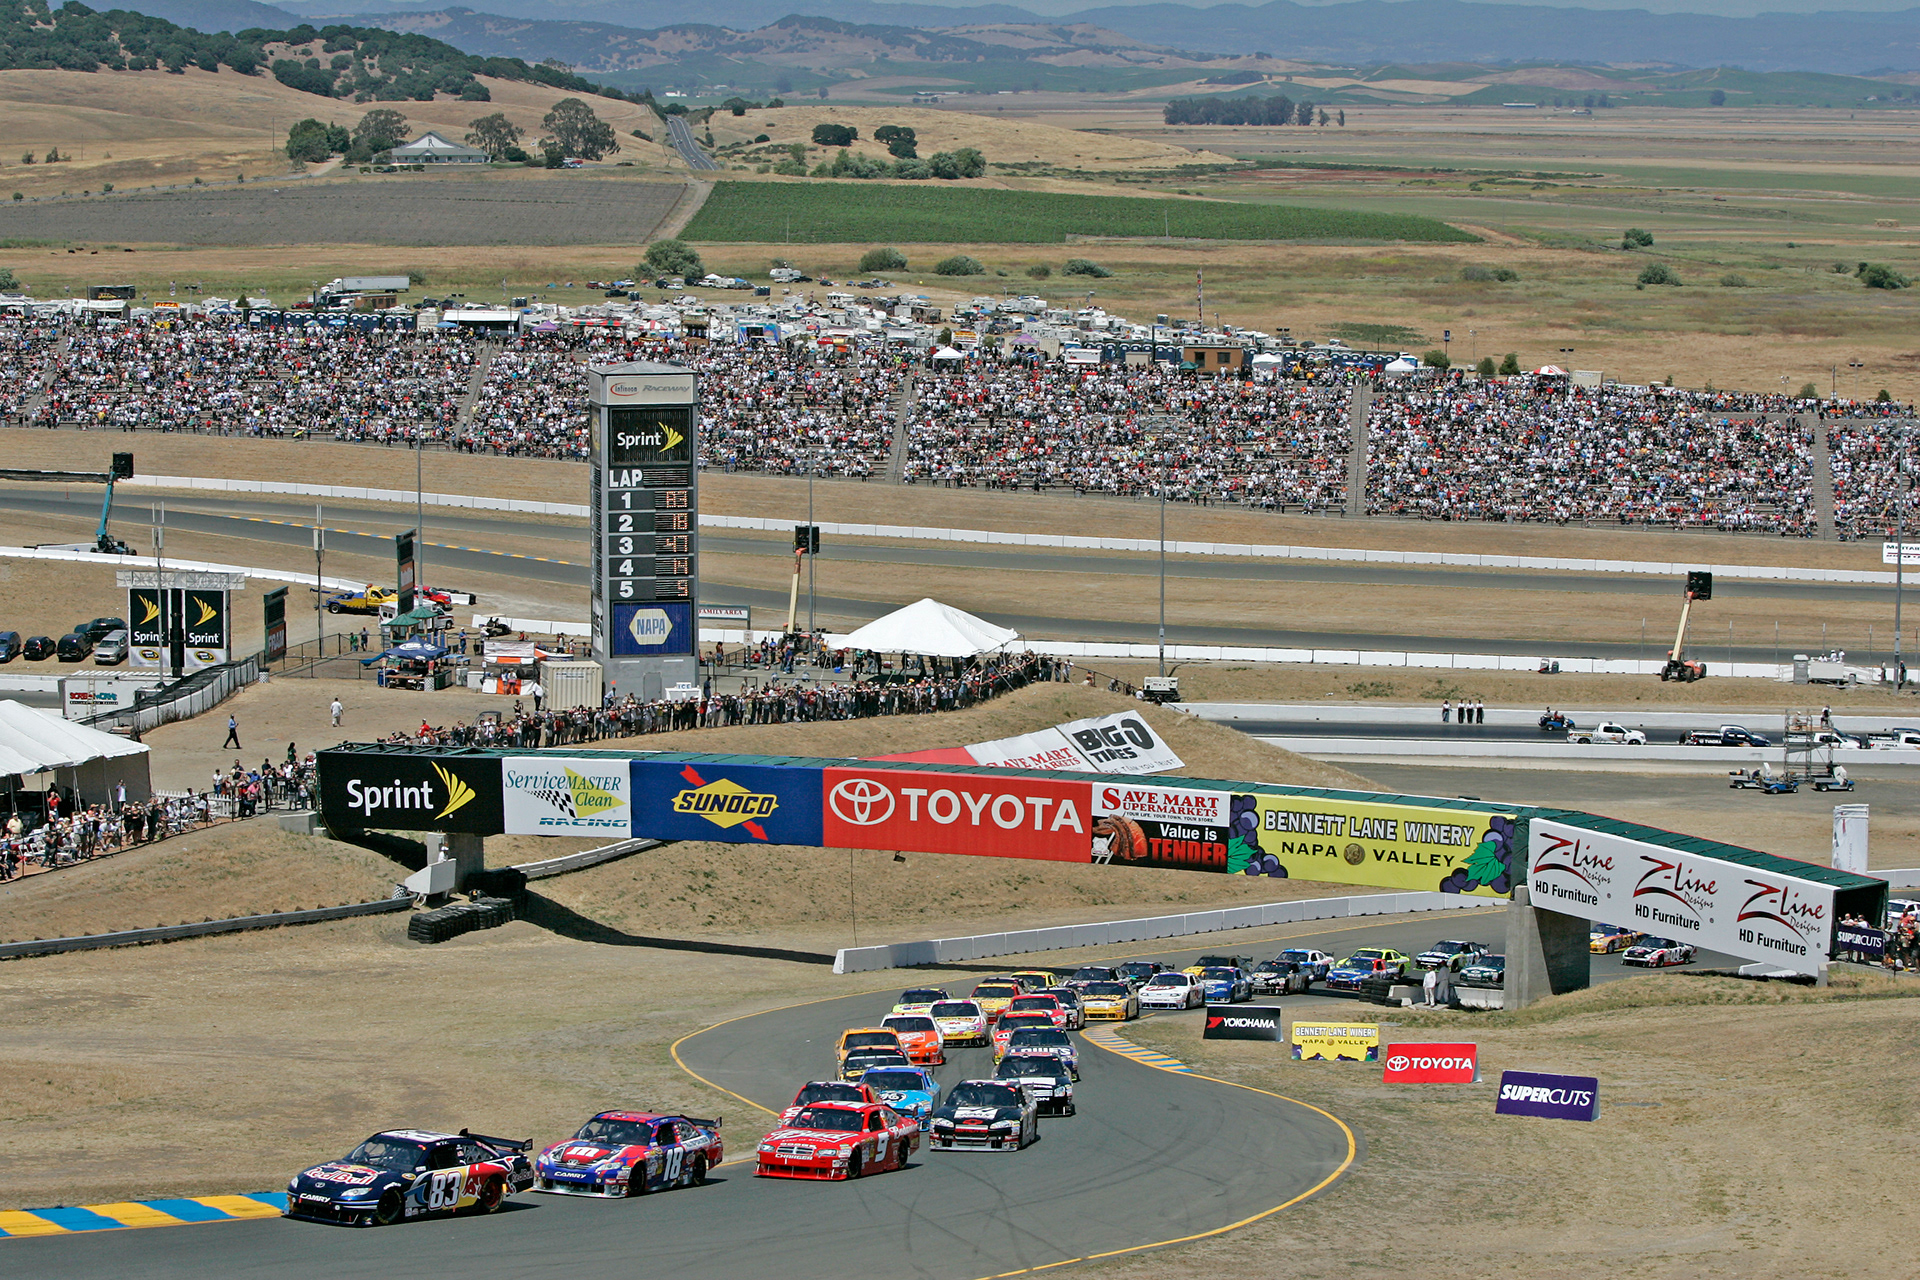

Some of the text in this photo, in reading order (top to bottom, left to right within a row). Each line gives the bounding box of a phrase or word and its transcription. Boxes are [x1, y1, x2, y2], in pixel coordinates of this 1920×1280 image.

[617, 431, 662, 450] Sprint
[609, 469, 643, 487] LAP
[621, 490, 688, 509] 1 83
[618, 513, 688, 531] 2 18
[618, 537, 633, 554] 3
[619, 559, 633, 576] 4
[619, 581, 633, 598] 5
[636, 617, 666, 635] NAPA
[134, 631, 162, 644] Sprin
[189, 632, 219, 644] Sprint
[1072, 725, 1127, 752] BIG
[1028, 747, 1074, 765] MART
[1089, 747, 1138, 763] TIRES
[347, 778, 434, 817] Sprint
[575, 790, 613, 808] Clean
[678, 793, 775, 816] SUNOCO
[1102, 787, 1219, 810] SAVE MART
[901, 787, 1084, 834] TOYOTA
[539, 816, 628, 828] RACING
[1264, 810, 1474, 846] BENNETT LANE WINERY
[1160, 823, 1218, 841] Value is
[1149, 838, 1227, 866] TENDER
[1281, 842, 1456, 867] NAPA VALLEY
[1533, 832, 1616, 874] Z-Line
[1582, 868, 1612, 885] Designs
[1632, 855, 1719, 899] Z-Line
[1535, 880, 1599, 906] HD Furniture
[1683, 891, 1714, 909] Designs
[1736, 879, 1826, 923] Z-Line
[1635, 903, 1700, 931] HD Furniture
[1789, 916, 1822, 934] Designs
[1739, 928, 1807, 957] HD Furniture
[1837, 930, 1882, 948] SUPERCUTS
[1223, 1016, 1275, 1029] YOKOHAMA
[1295, 1026, 1377, 1038] BENNETT LANE WINERY
[1411, 1056, 1473, 1071] TOYOTA
[1500, 1083, 1591, 1107] SUPERCUTS
[874, 1131, 890, 1163] 9
[663, 1147, 684, 1182] 18
[554, 1171, 587, 1179] CAMRY
[299, 1193, 331, 1203] CAMRY
[428, 1171, 462, 1211] 83
